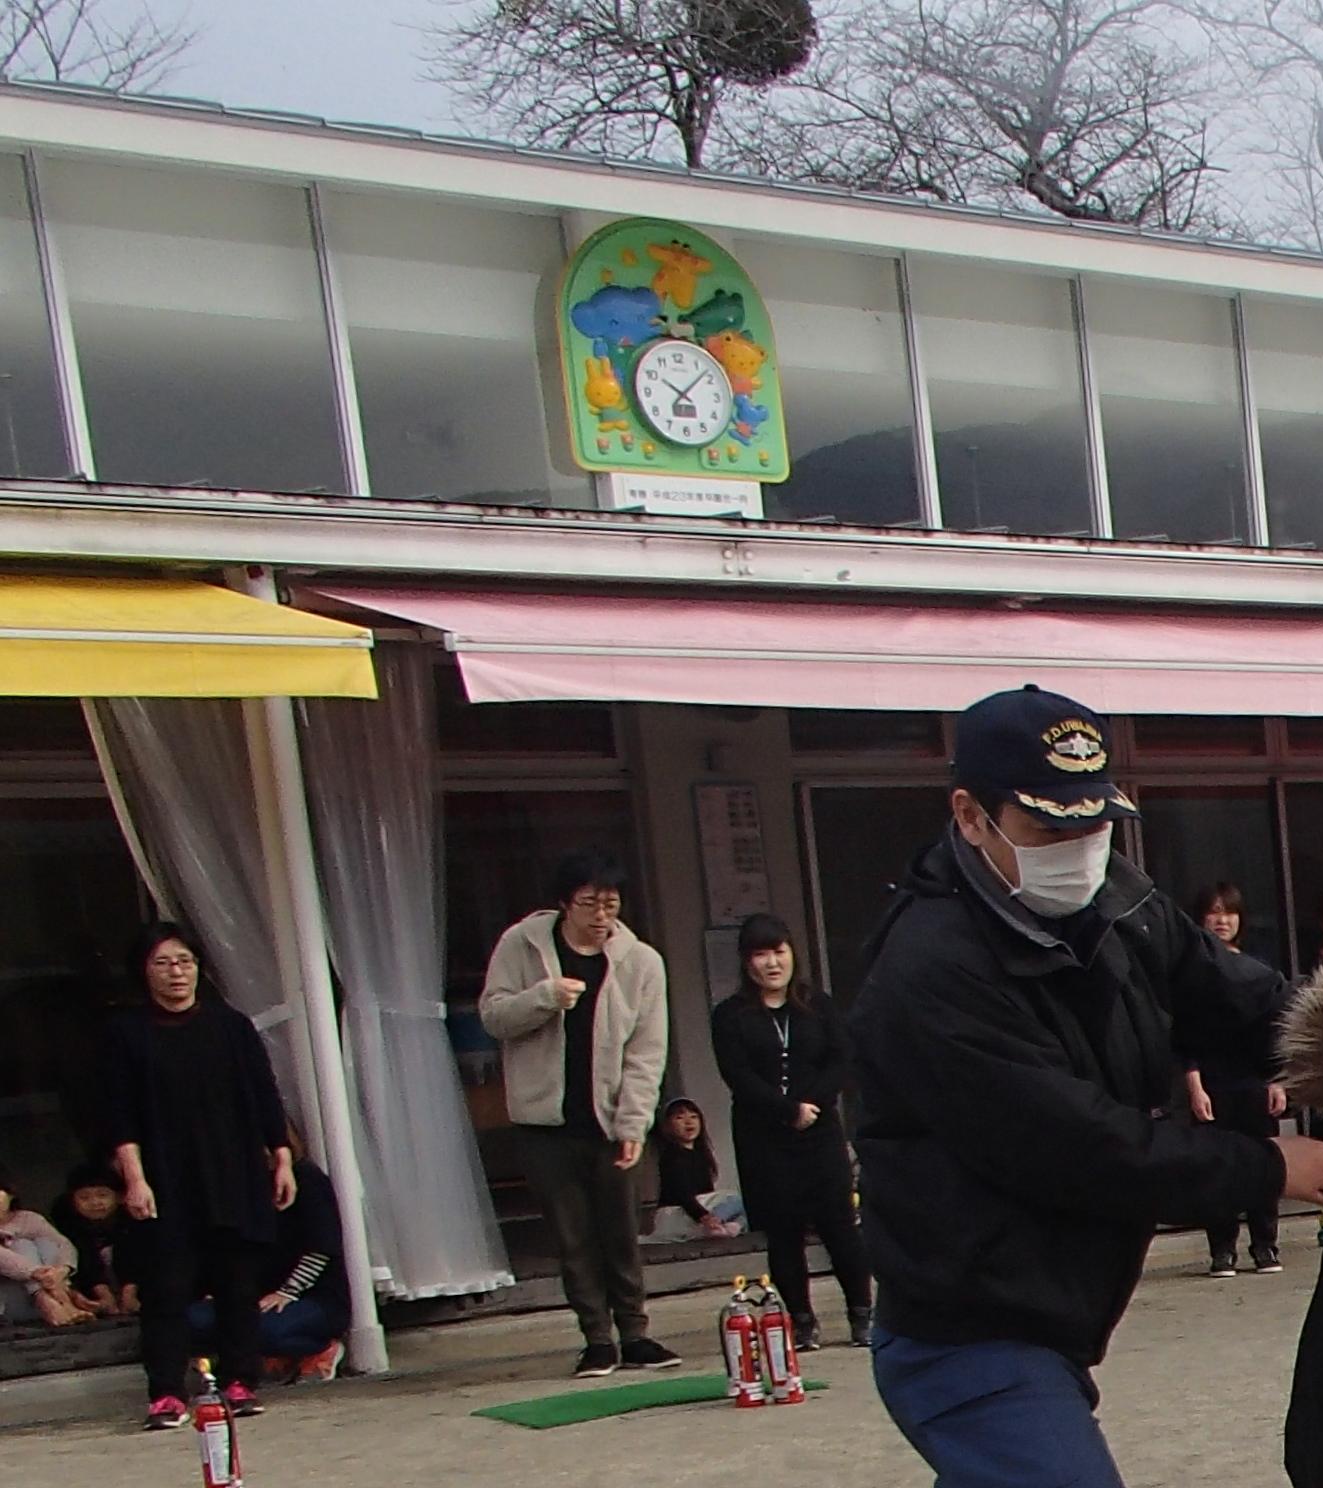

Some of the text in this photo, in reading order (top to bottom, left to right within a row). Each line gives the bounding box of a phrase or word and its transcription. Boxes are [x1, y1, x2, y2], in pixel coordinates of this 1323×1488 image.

[657, 357, 667, 368] 11
[673, 353, 684, 364] 12
[694, 361, 699, 370] 1
[646, 370, 658, 381] 10
[707, 374, 714, 385] 2
[644, 387, 652, 397] 9
[713, 393, 720, 403] 3
[652, 406, 660, 416] 8
[711, 411, 718, 420] 4
[666, 420, 673, 430] 7
[699, 422, 708, 433] 5
[682, 426, 691, 437] 6
